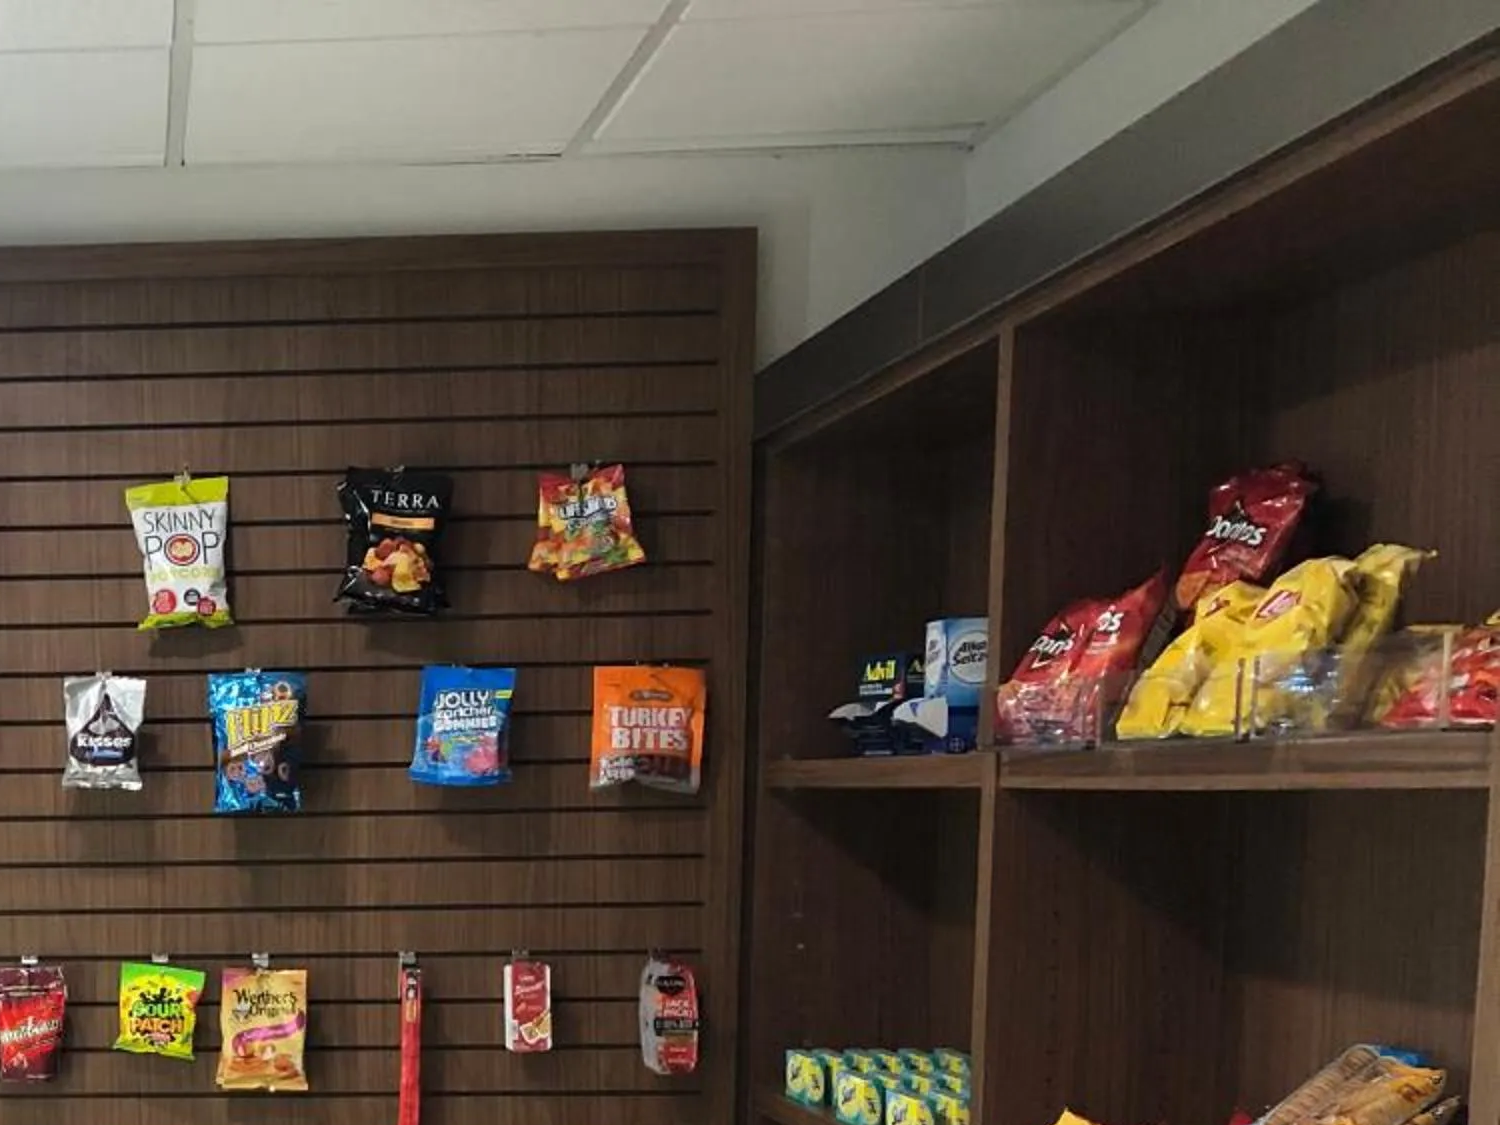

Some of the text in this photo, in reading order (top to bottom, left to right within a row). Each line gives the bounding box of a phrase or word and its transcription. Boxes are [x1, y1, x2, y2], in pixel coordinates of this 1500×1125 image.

[371, 489, 440, 509] TERRA
[143, 507, 216, 535] SKINNY
[144, 531, 220, 571] POP
[864, 659, 896, 682] Advil
[436, 689, 490, 709] JOLLY
[609, 706, 692, 728] TURKEY
[611, 728, 688, 751] BITES
[131, 1000, 182, 1017] SOUR
[130, 1017, 183, 1034] PATCH
